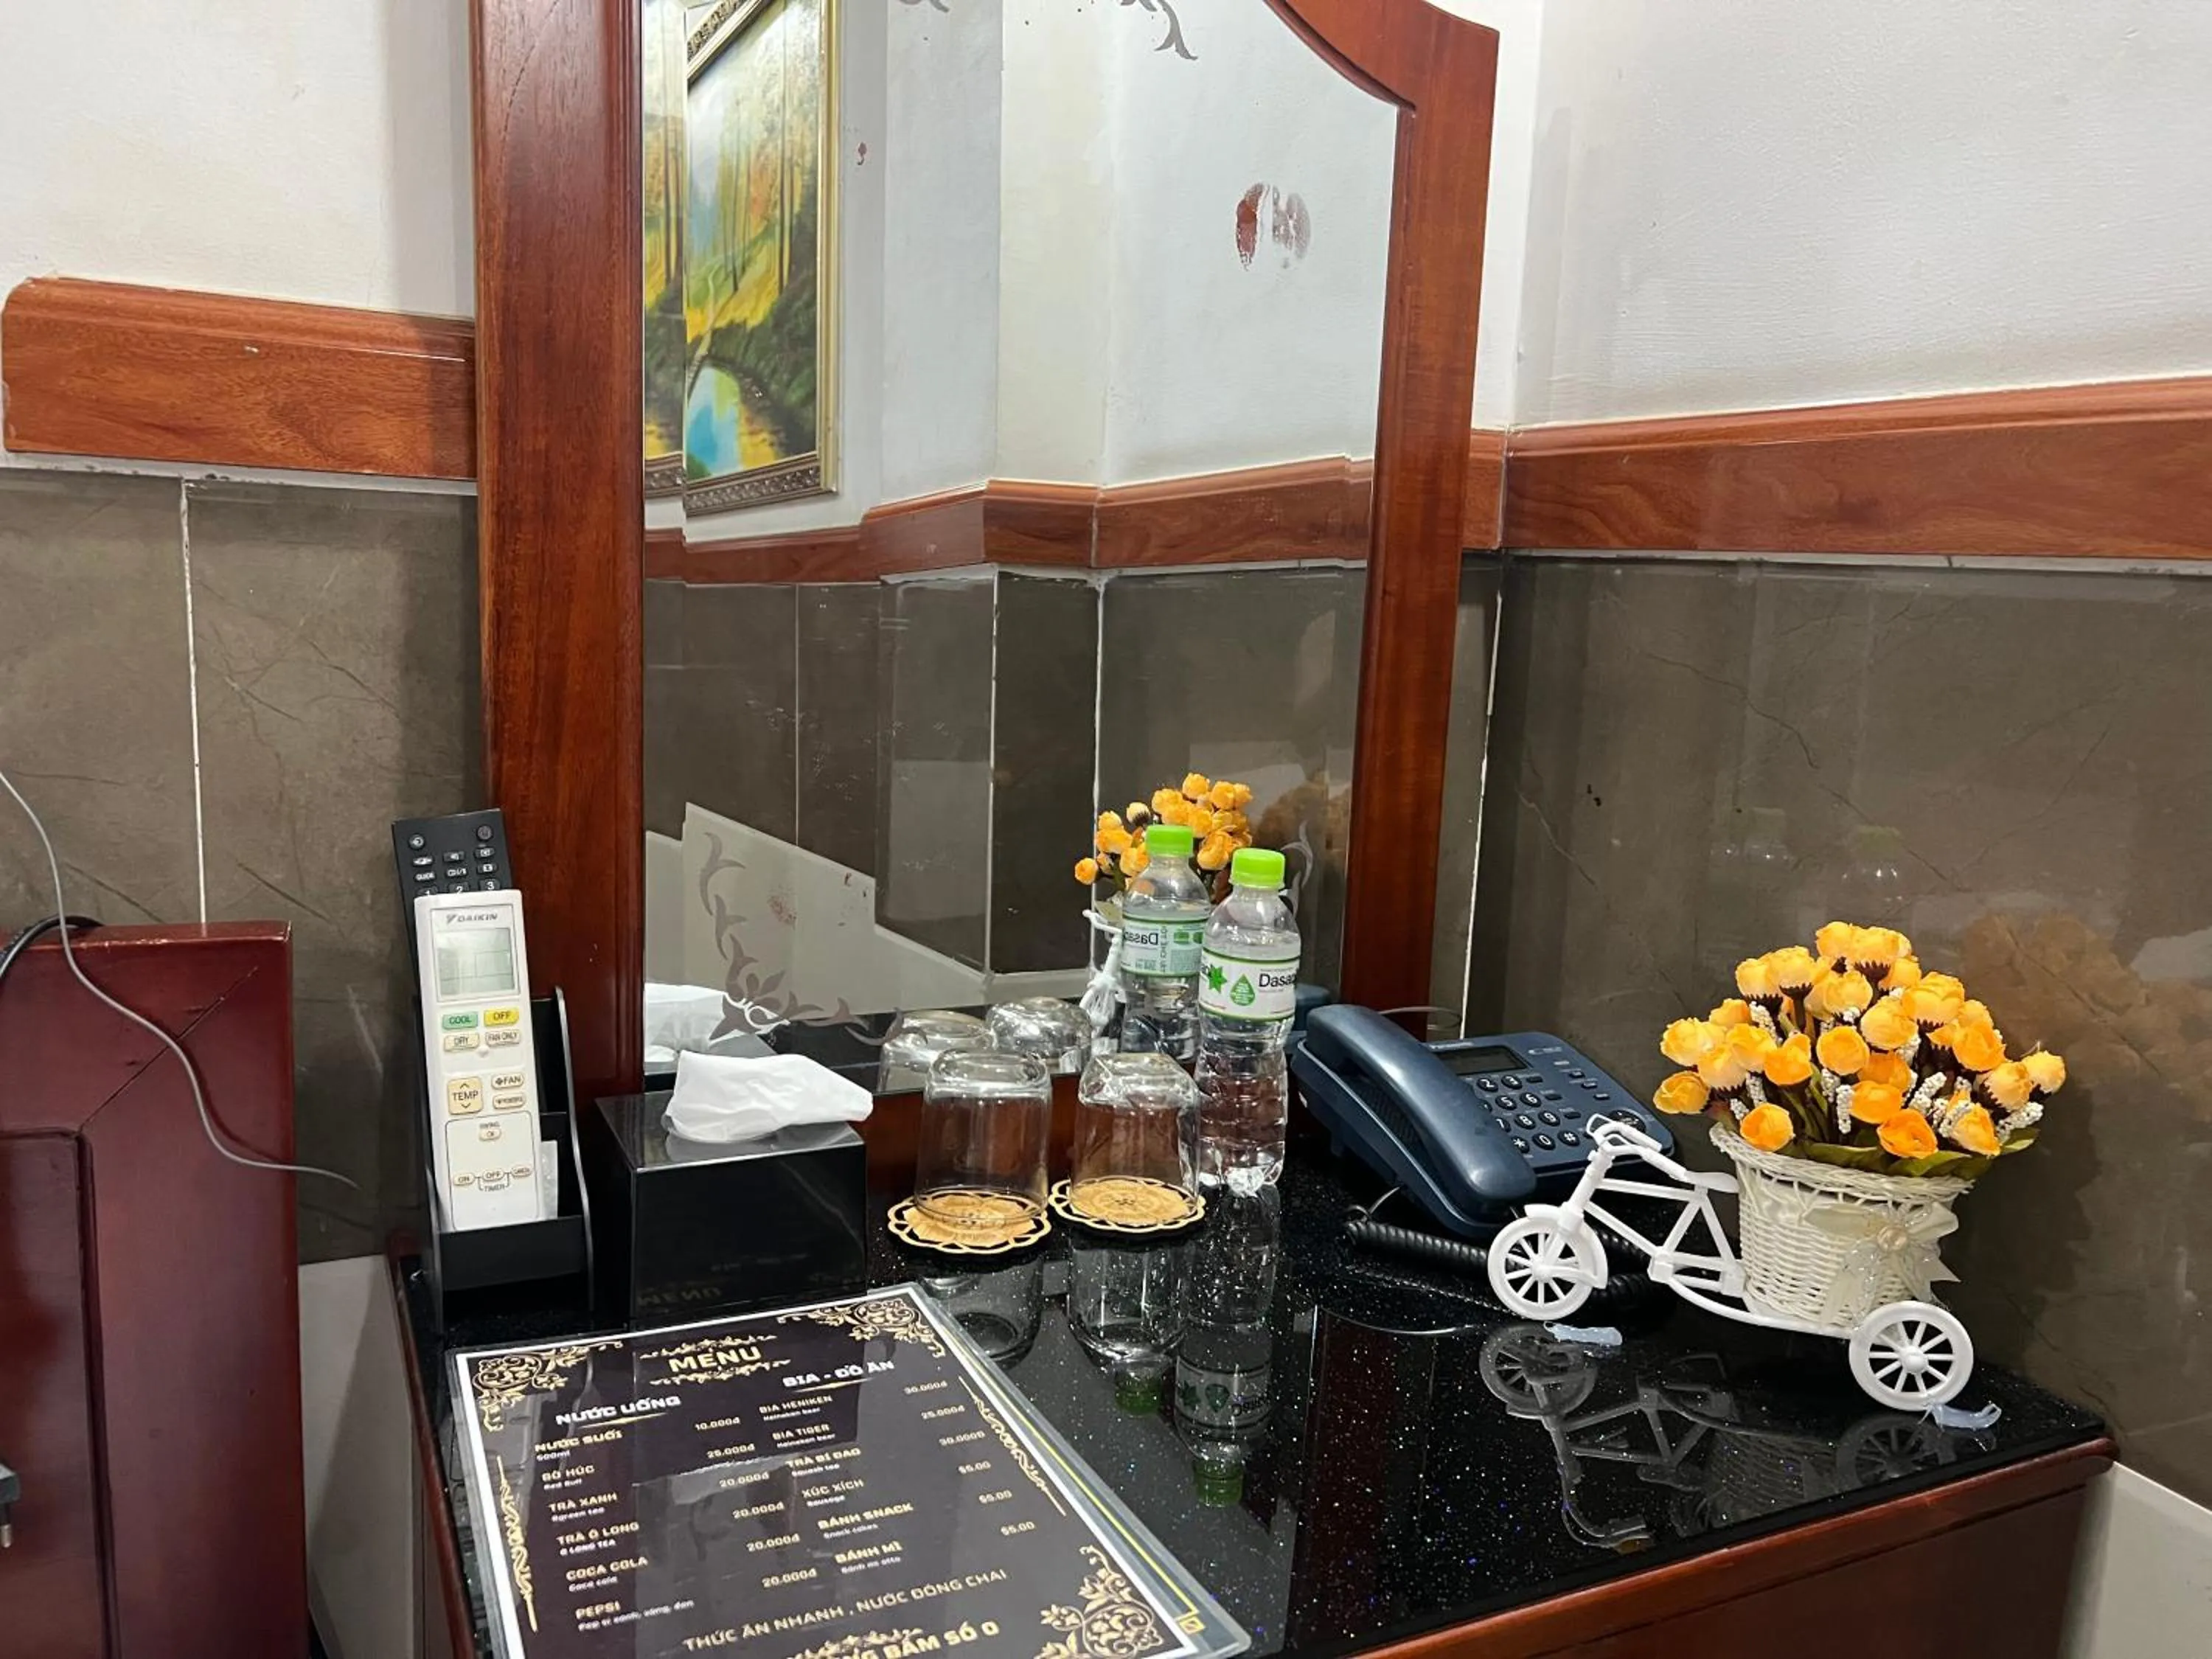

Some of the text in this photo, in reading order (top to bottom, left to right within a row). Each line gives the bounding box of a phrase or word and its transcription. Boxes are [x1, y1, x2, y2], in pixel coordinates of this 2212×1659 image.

[415, 871, 435, 881] GUIDE
[486, 881, 495, 891] 3
[457, 914, 498, 922] DAIKIN
[448, 1015, 472, 1025] COOL
[493, 1011, 512, 1021] OFF
[453, 1036, 469, 1046] DRY
[504, 1076, 521, 1085] FAN
[1480, 1076, 1519, 1088] 2 3
[452, 1091, 479, 1101] TEMP
[1500, 1093, 1538, 1107] 5 6
[1519, 1115, 1533, 1127] 8
[1543, 1112, 1557, 1123] 9
[1539, 1135, 1551, 1146] 0
[486, 1171, 500, 1179] OFF
[484, 1184, 505, 1192] TIMER
[668, 1346, 762, 1372] MENU
[782, 1373, 820, 1388] BIA
[759, 1404, 779, 1414] BIA
[772, 1423, 830, 1440] BIA TIGER
[548, 1492, 618, 1512] TRÀ XANH
[817, 1502, 914, 1530] BÁNH SNACK
[556, 1531, 585, 1545] TRÀ
[602, 1521, 640, 1537] LONG
[835, 1546, 880, 1564] BÁNH
[566, 1557, 649, 1582] COCA COLA
[762, 1568, 818, 1587] 20.000đ
[773, 1605, 844, 1631] NHANH
[965, 1568, 1007, 1587] CHAI
[575, 1600, 621, 1620] PEPSI
